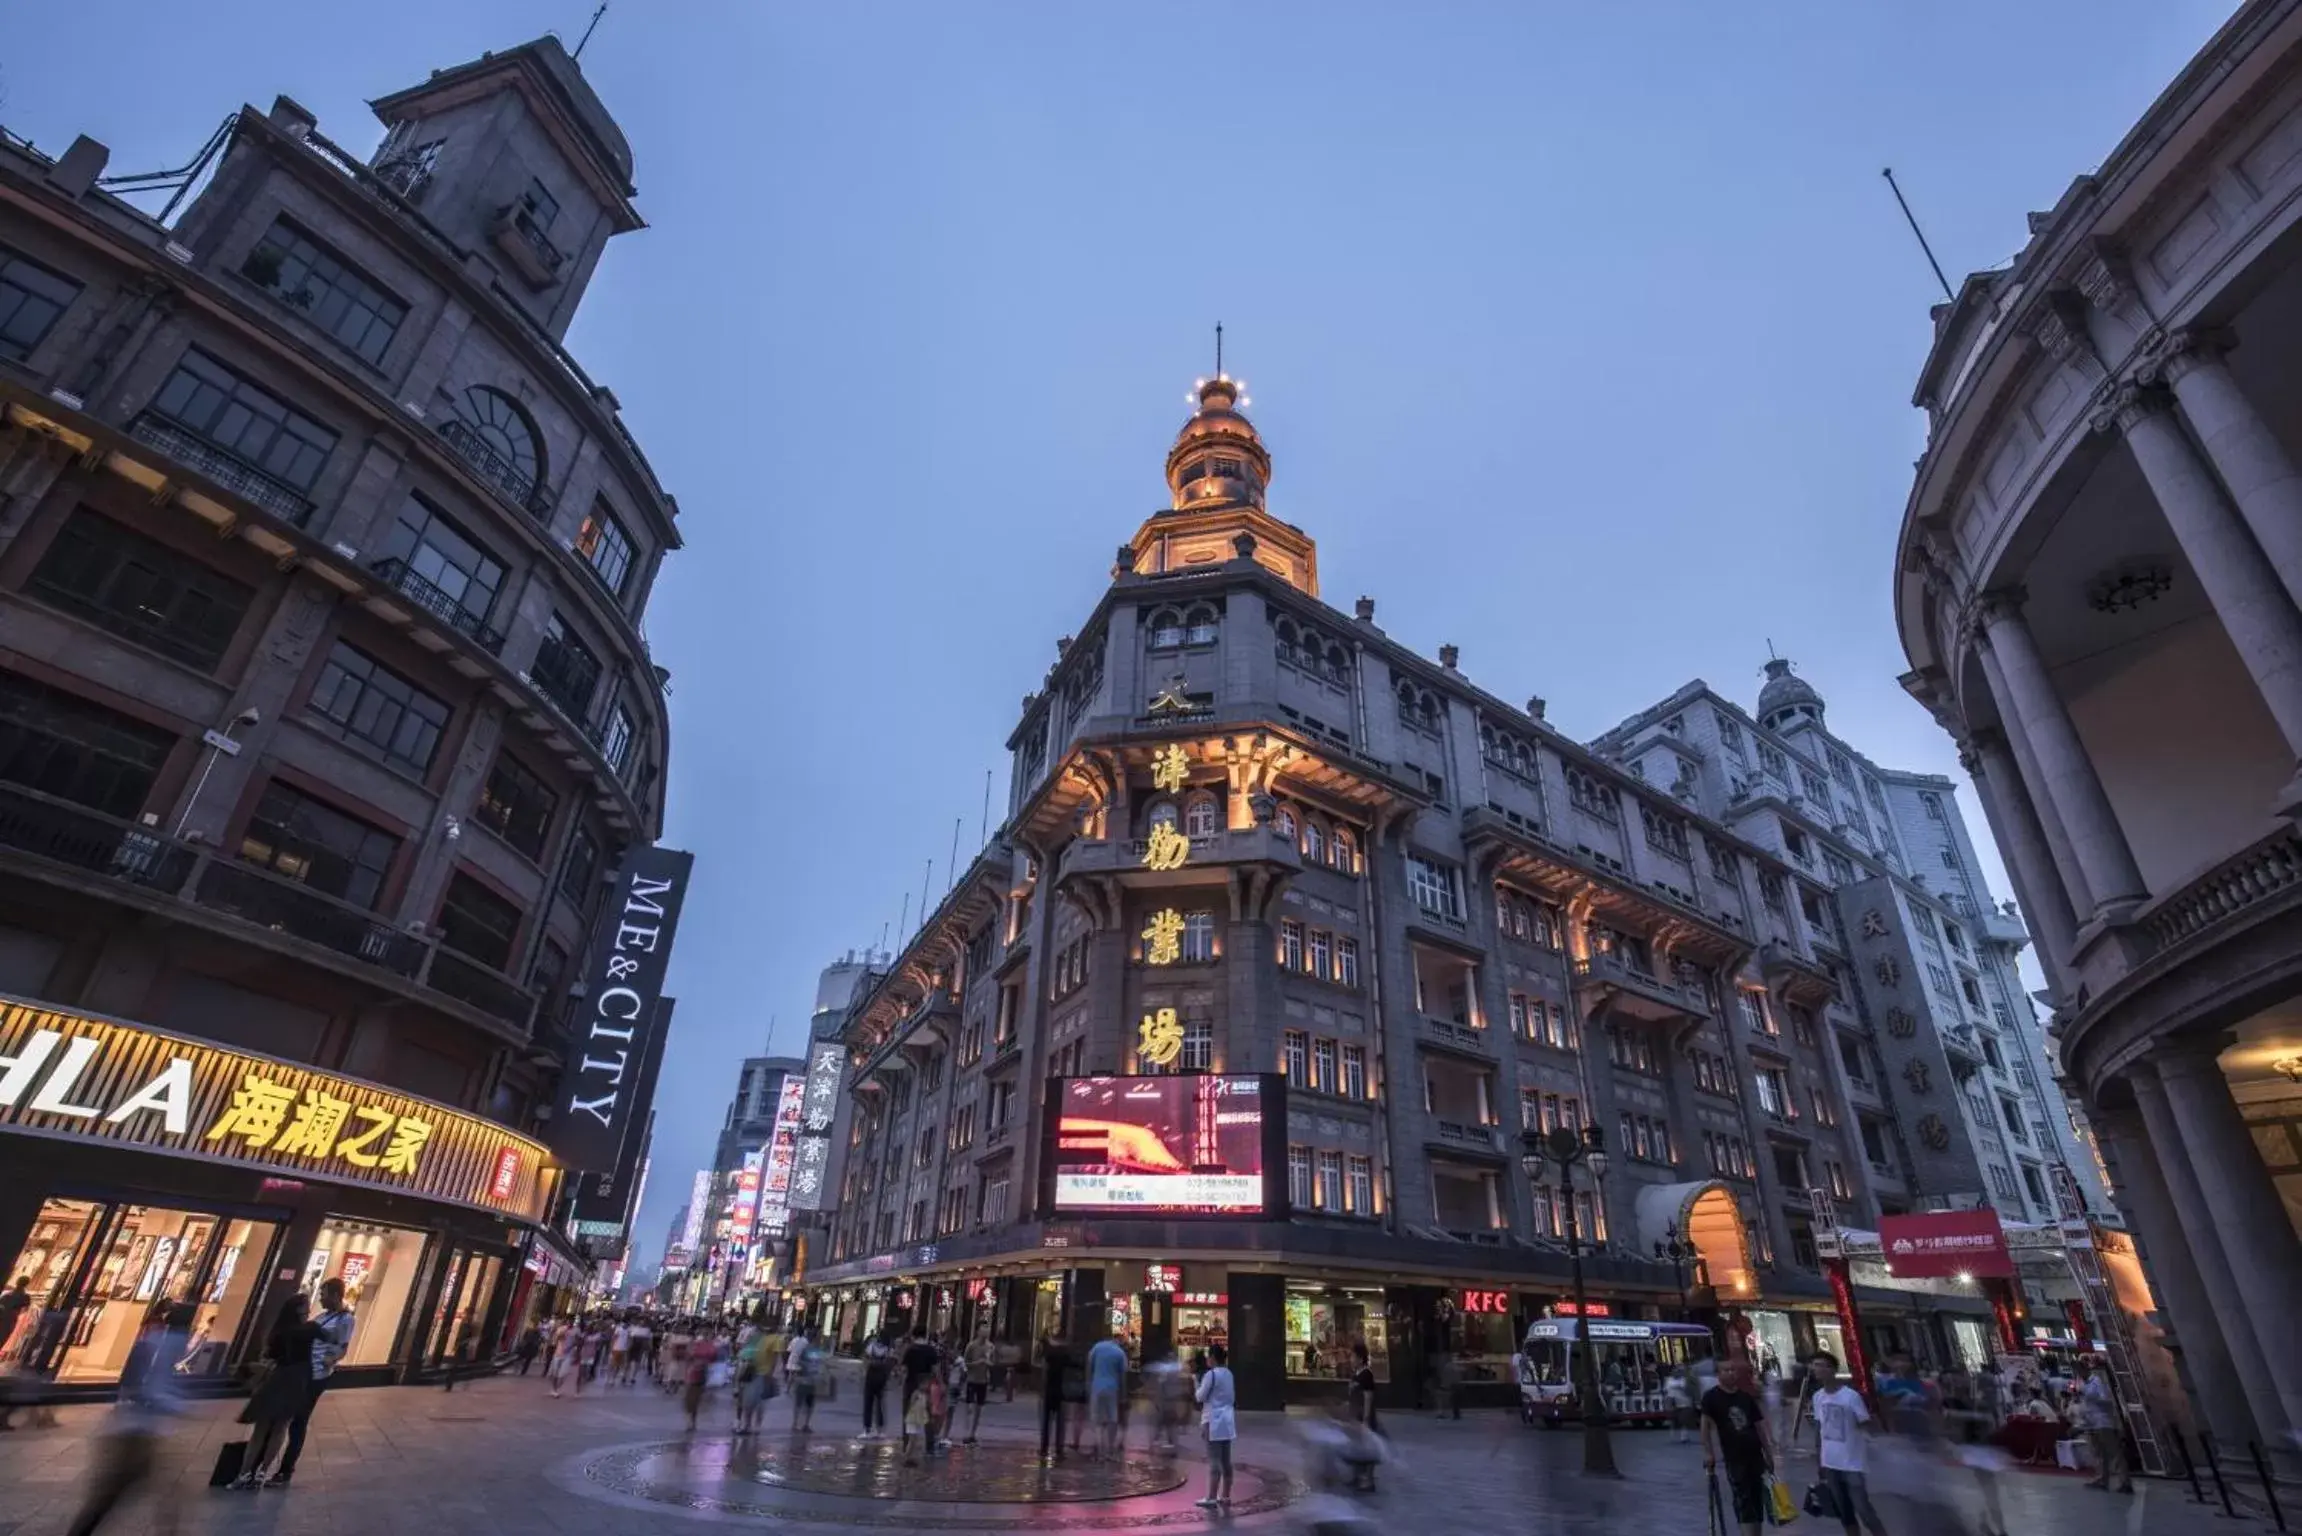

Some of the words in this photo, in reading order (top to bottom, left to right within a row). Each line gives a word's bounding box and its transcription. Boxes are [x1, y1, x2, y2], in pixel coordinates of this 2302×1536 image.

[570, 873, 673, 1128] ME&CITY
[207, 1076, 432, 1176] 海澜之家
[1464, 1289, 1508, 1313] KFC
